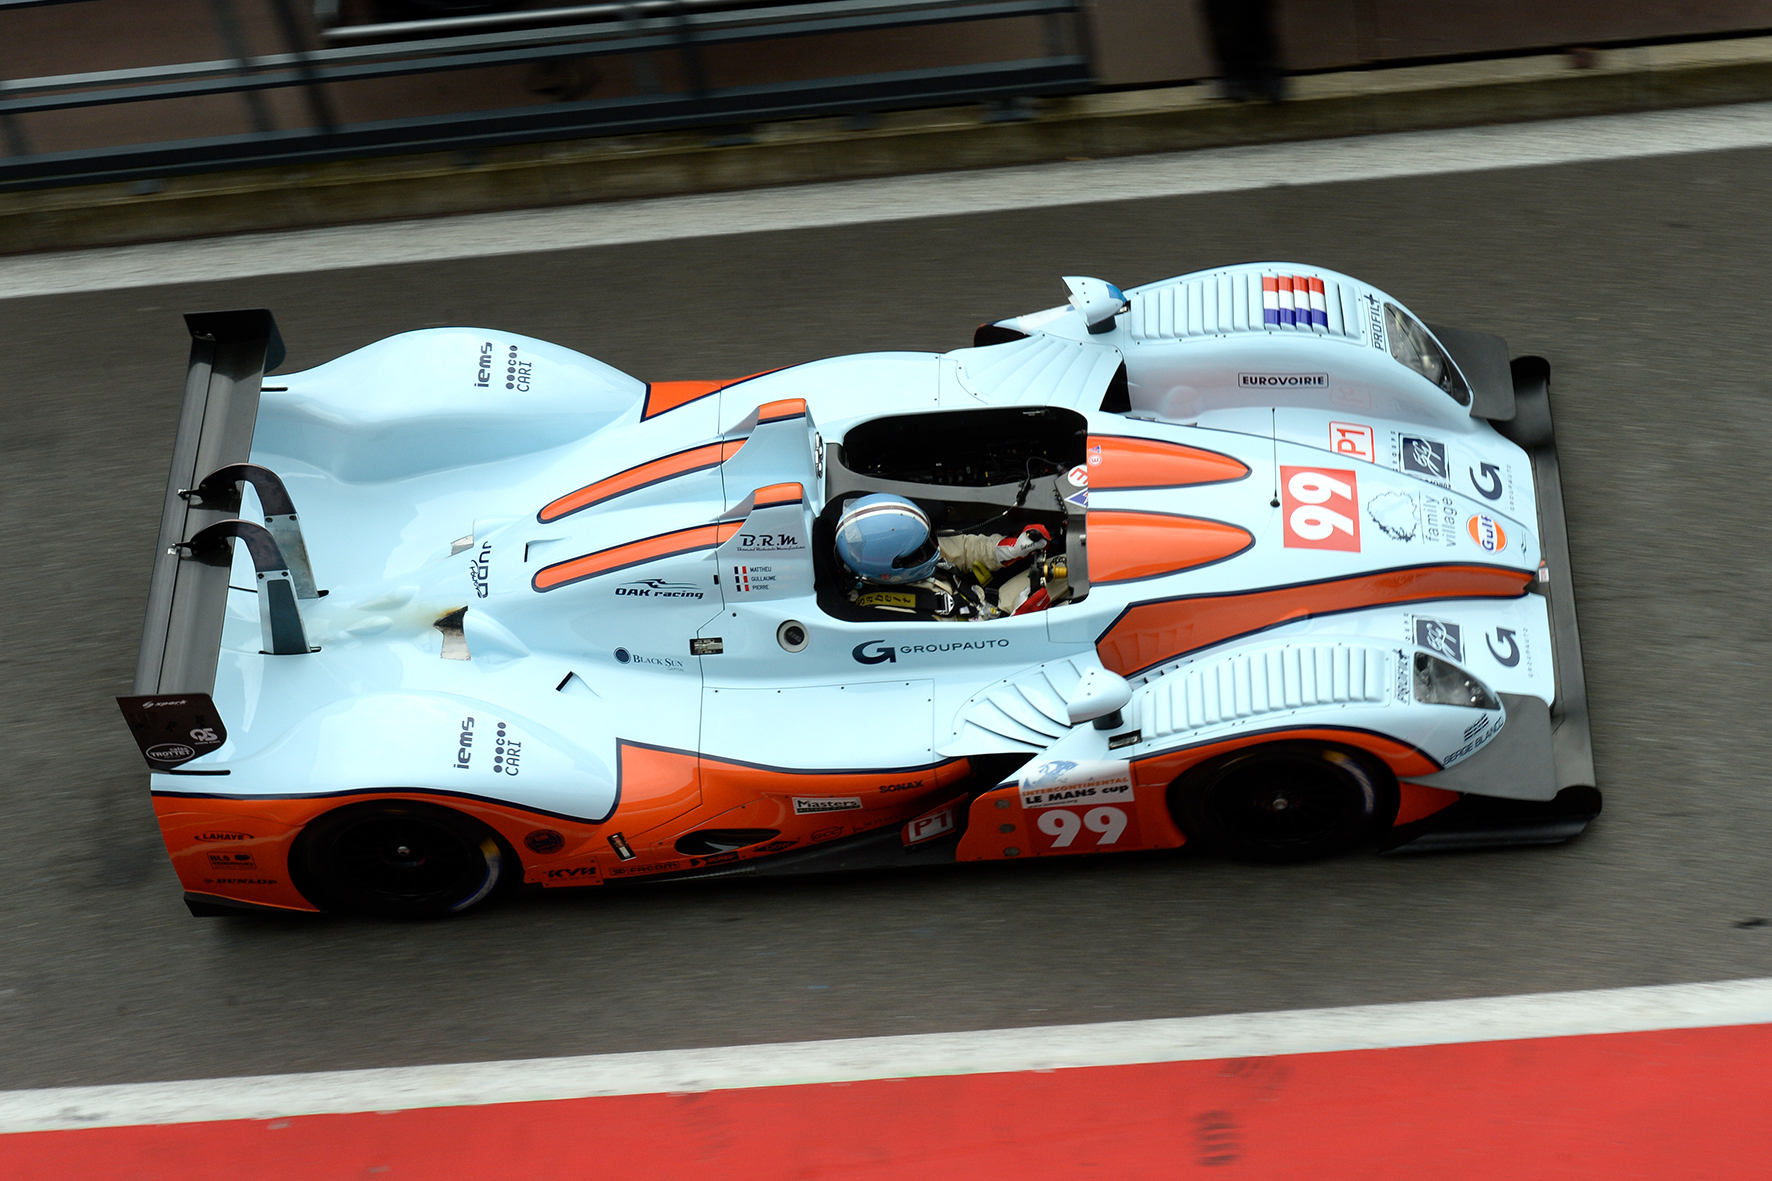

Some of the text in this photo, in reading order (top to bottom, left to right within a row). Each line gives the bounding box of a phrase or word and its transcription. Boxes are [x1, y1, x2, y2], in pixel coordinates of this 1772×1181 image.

[474, 342, 493, 387] iems
[516, 361, 532, 392] CARI
[1242, 376, 1324, 385] EUROVOIRIE
[1337, 428, 1366, 455] P1
[1288, 472, 1353, 540] 99
[1423, 495, 1440, 542] family
[1442, 497, 1457, 547] village
[1481, 514, 1495, 551] Gulf
[477, 541, 492, 598] JUDD
[615, 587, 704, 600] OAK racing
[900, 639, 1009, 654] GROUPAUTO
[453, 716, 475, 770] iems
[1443, 742, 1475, 764] SERGE
[505, 740, 521, 776] CARI
[879, 780, 923, 793] SONAX
[1022, 777, 1129, 796] INTERCONTINENTAL
[1026, 785, 1129, 804] LE MANS cup
[797, 800, 859, 809] Masters
[203, 833, 245, 841] LAHAYE
[914, 814, 948, 837] P1
[1037, 806, 1128, 848] 99
